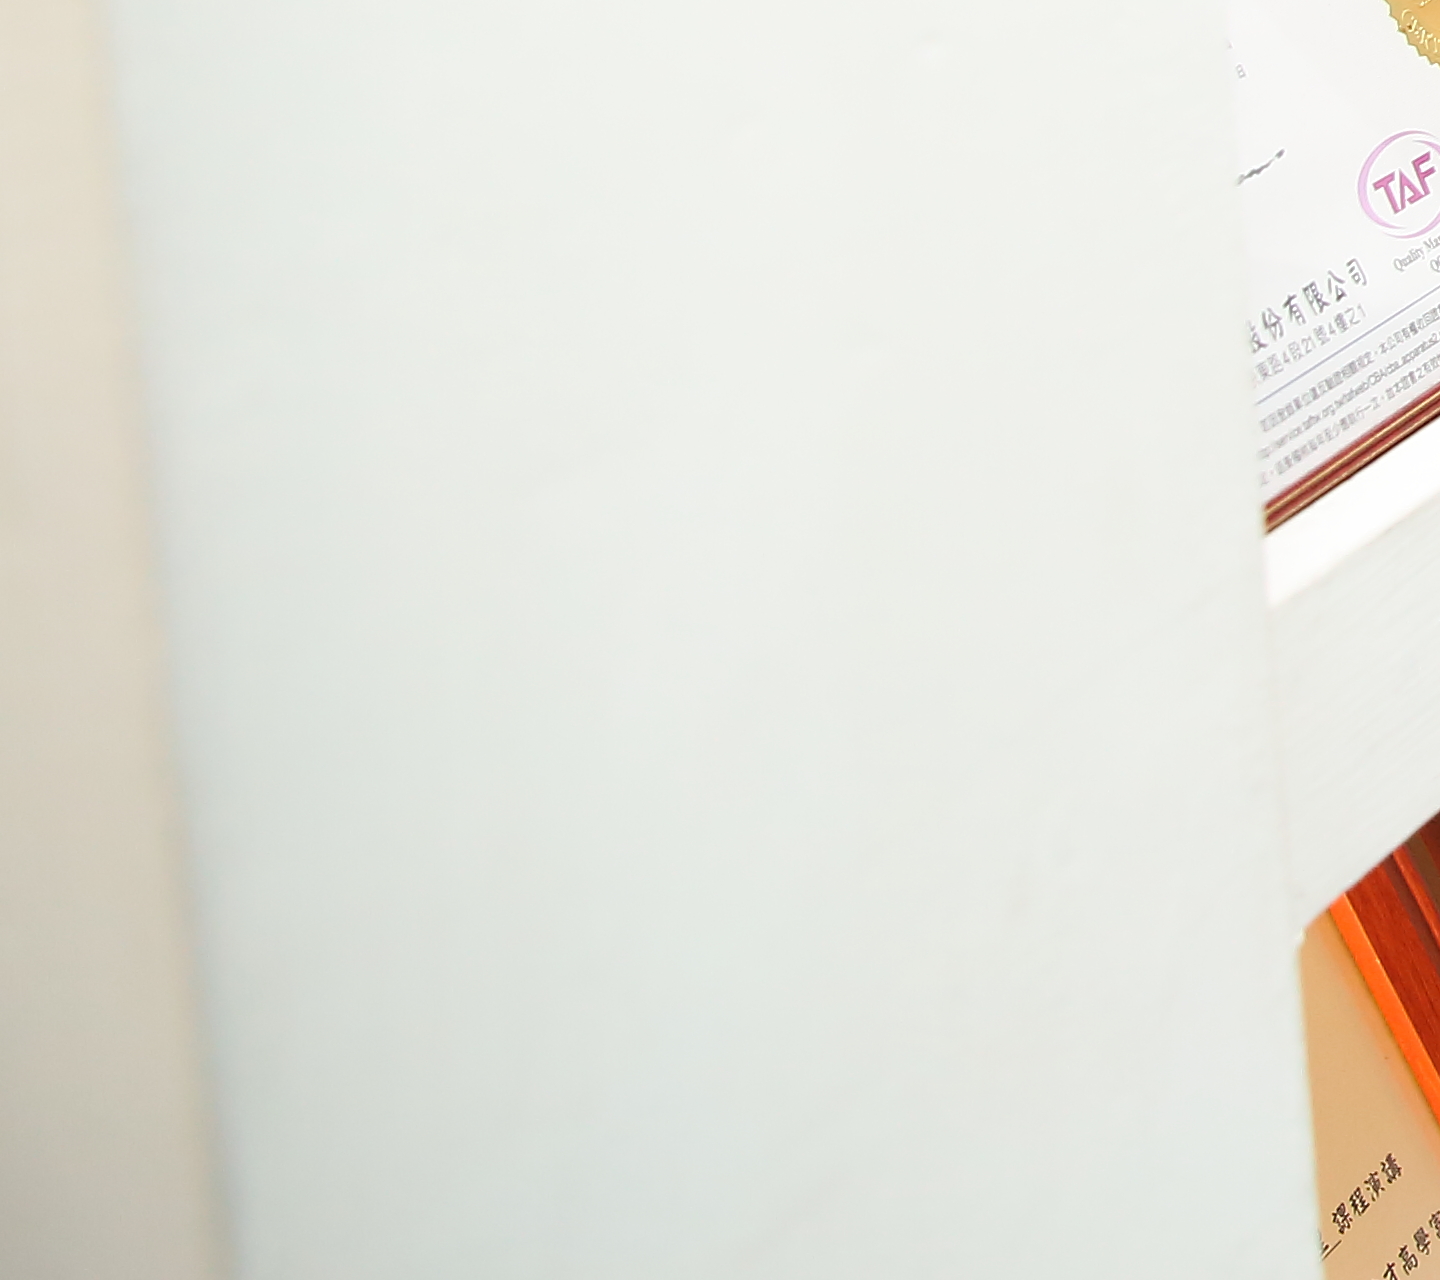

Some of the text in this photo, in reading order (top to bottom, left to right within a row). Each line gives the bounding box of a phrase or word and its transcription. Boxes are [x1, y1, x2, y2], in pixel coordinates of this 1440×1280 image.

[1373, 151, 1436, 214] TAF
[1393, 244, 1425, 272] Quality
[1332, 1152, 1403, 1235] 課程演講
